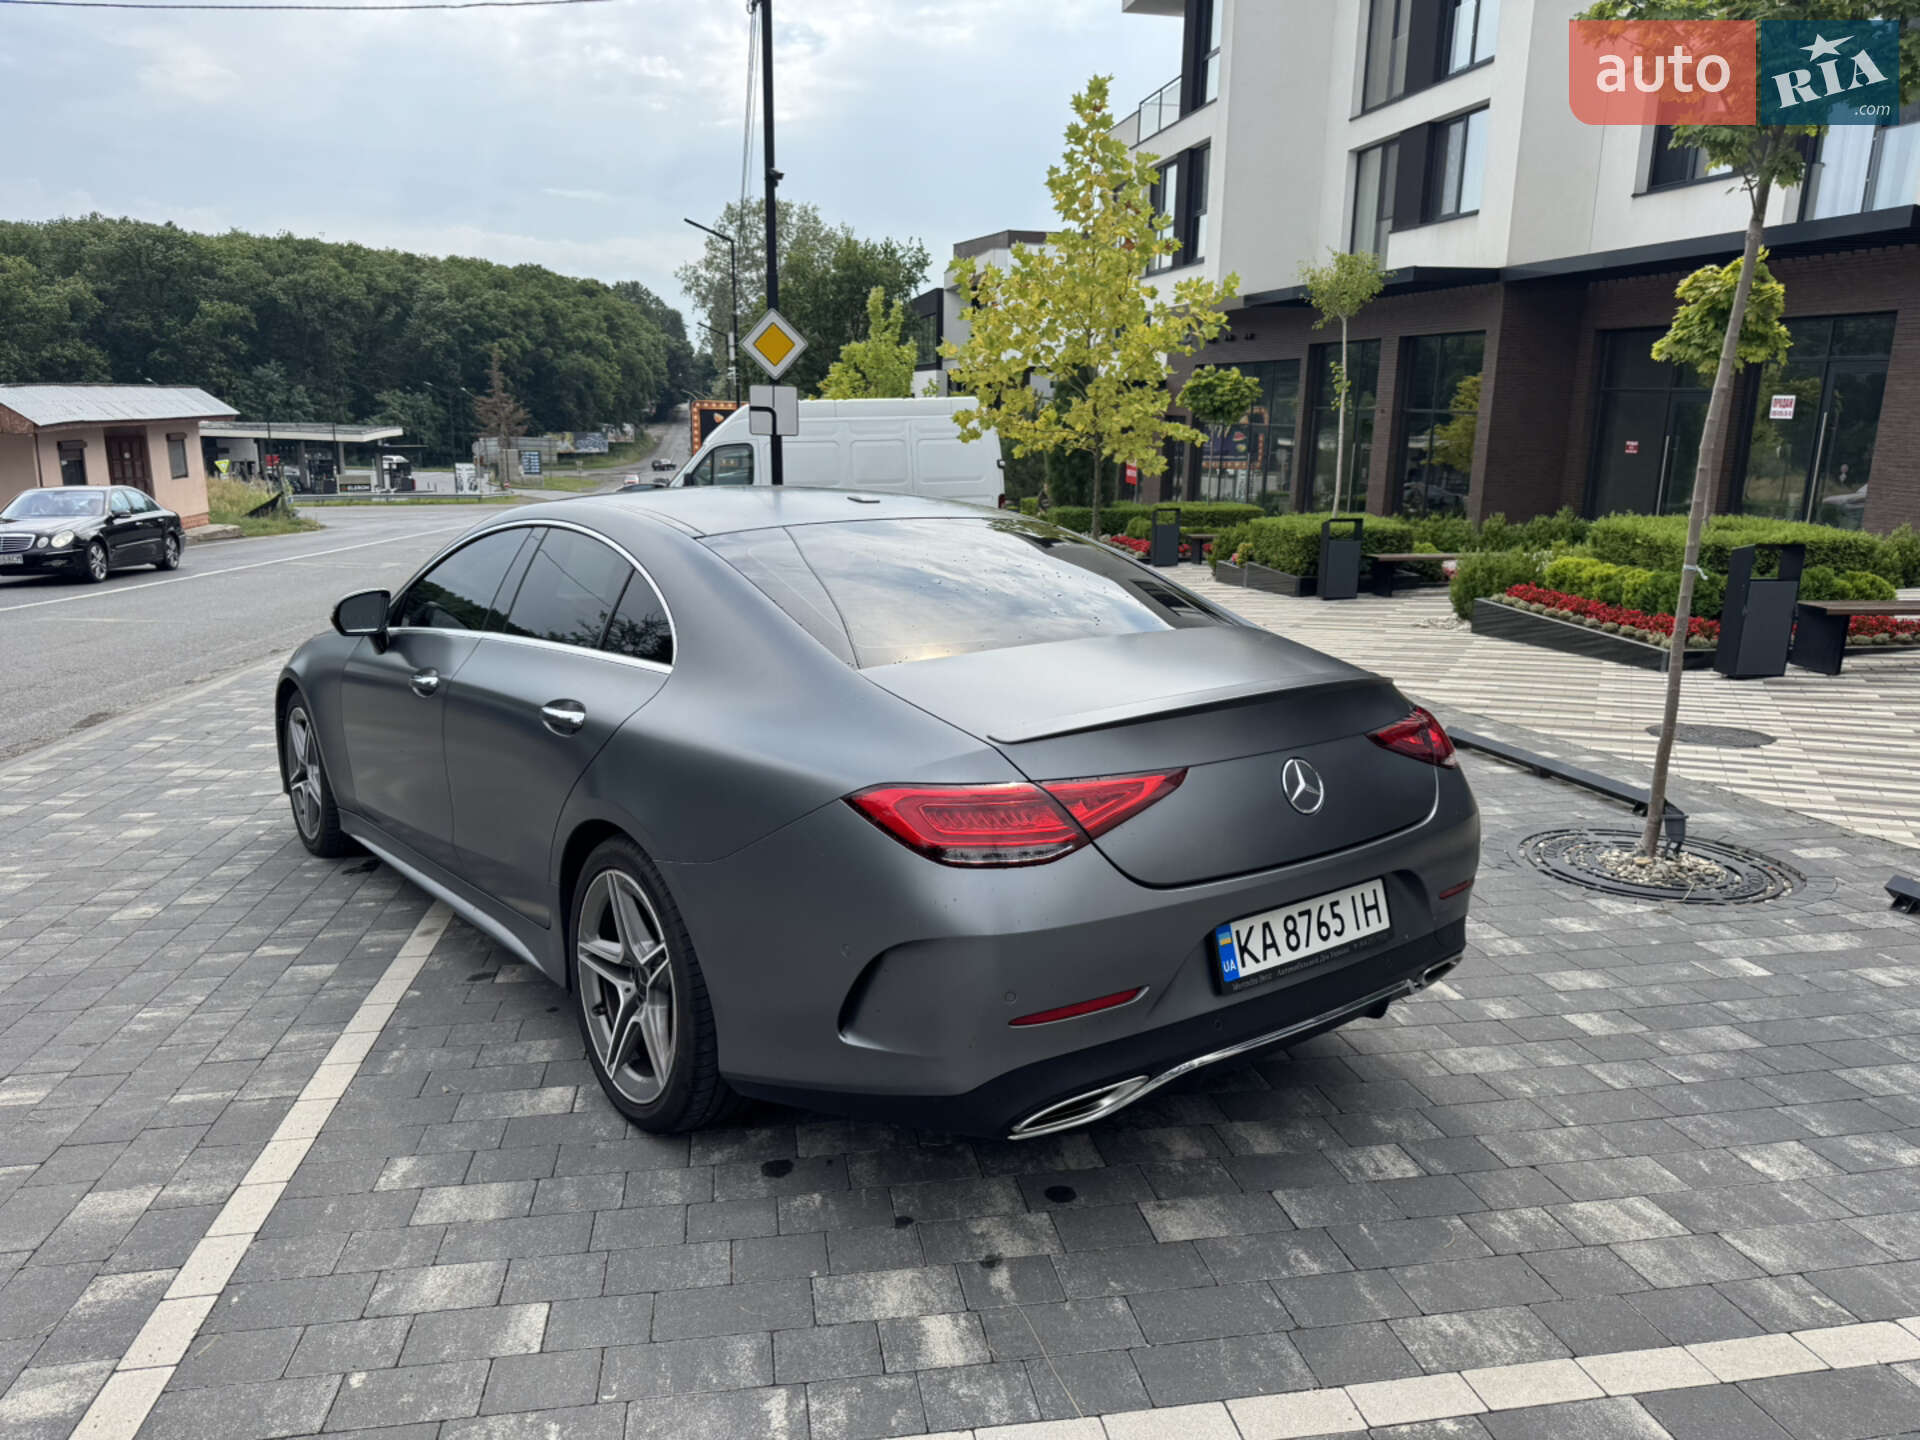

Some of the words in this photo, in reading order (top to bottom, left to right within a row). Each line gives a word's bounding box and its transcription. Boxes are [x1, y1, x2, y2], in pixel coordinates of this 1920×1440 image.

[1235, 920, 1282, 969] KA
[1283, 900, 1346, 952] 8765
[1351, 888, 1382, 931] IH
[1223, 960, 1237, 973] UA
